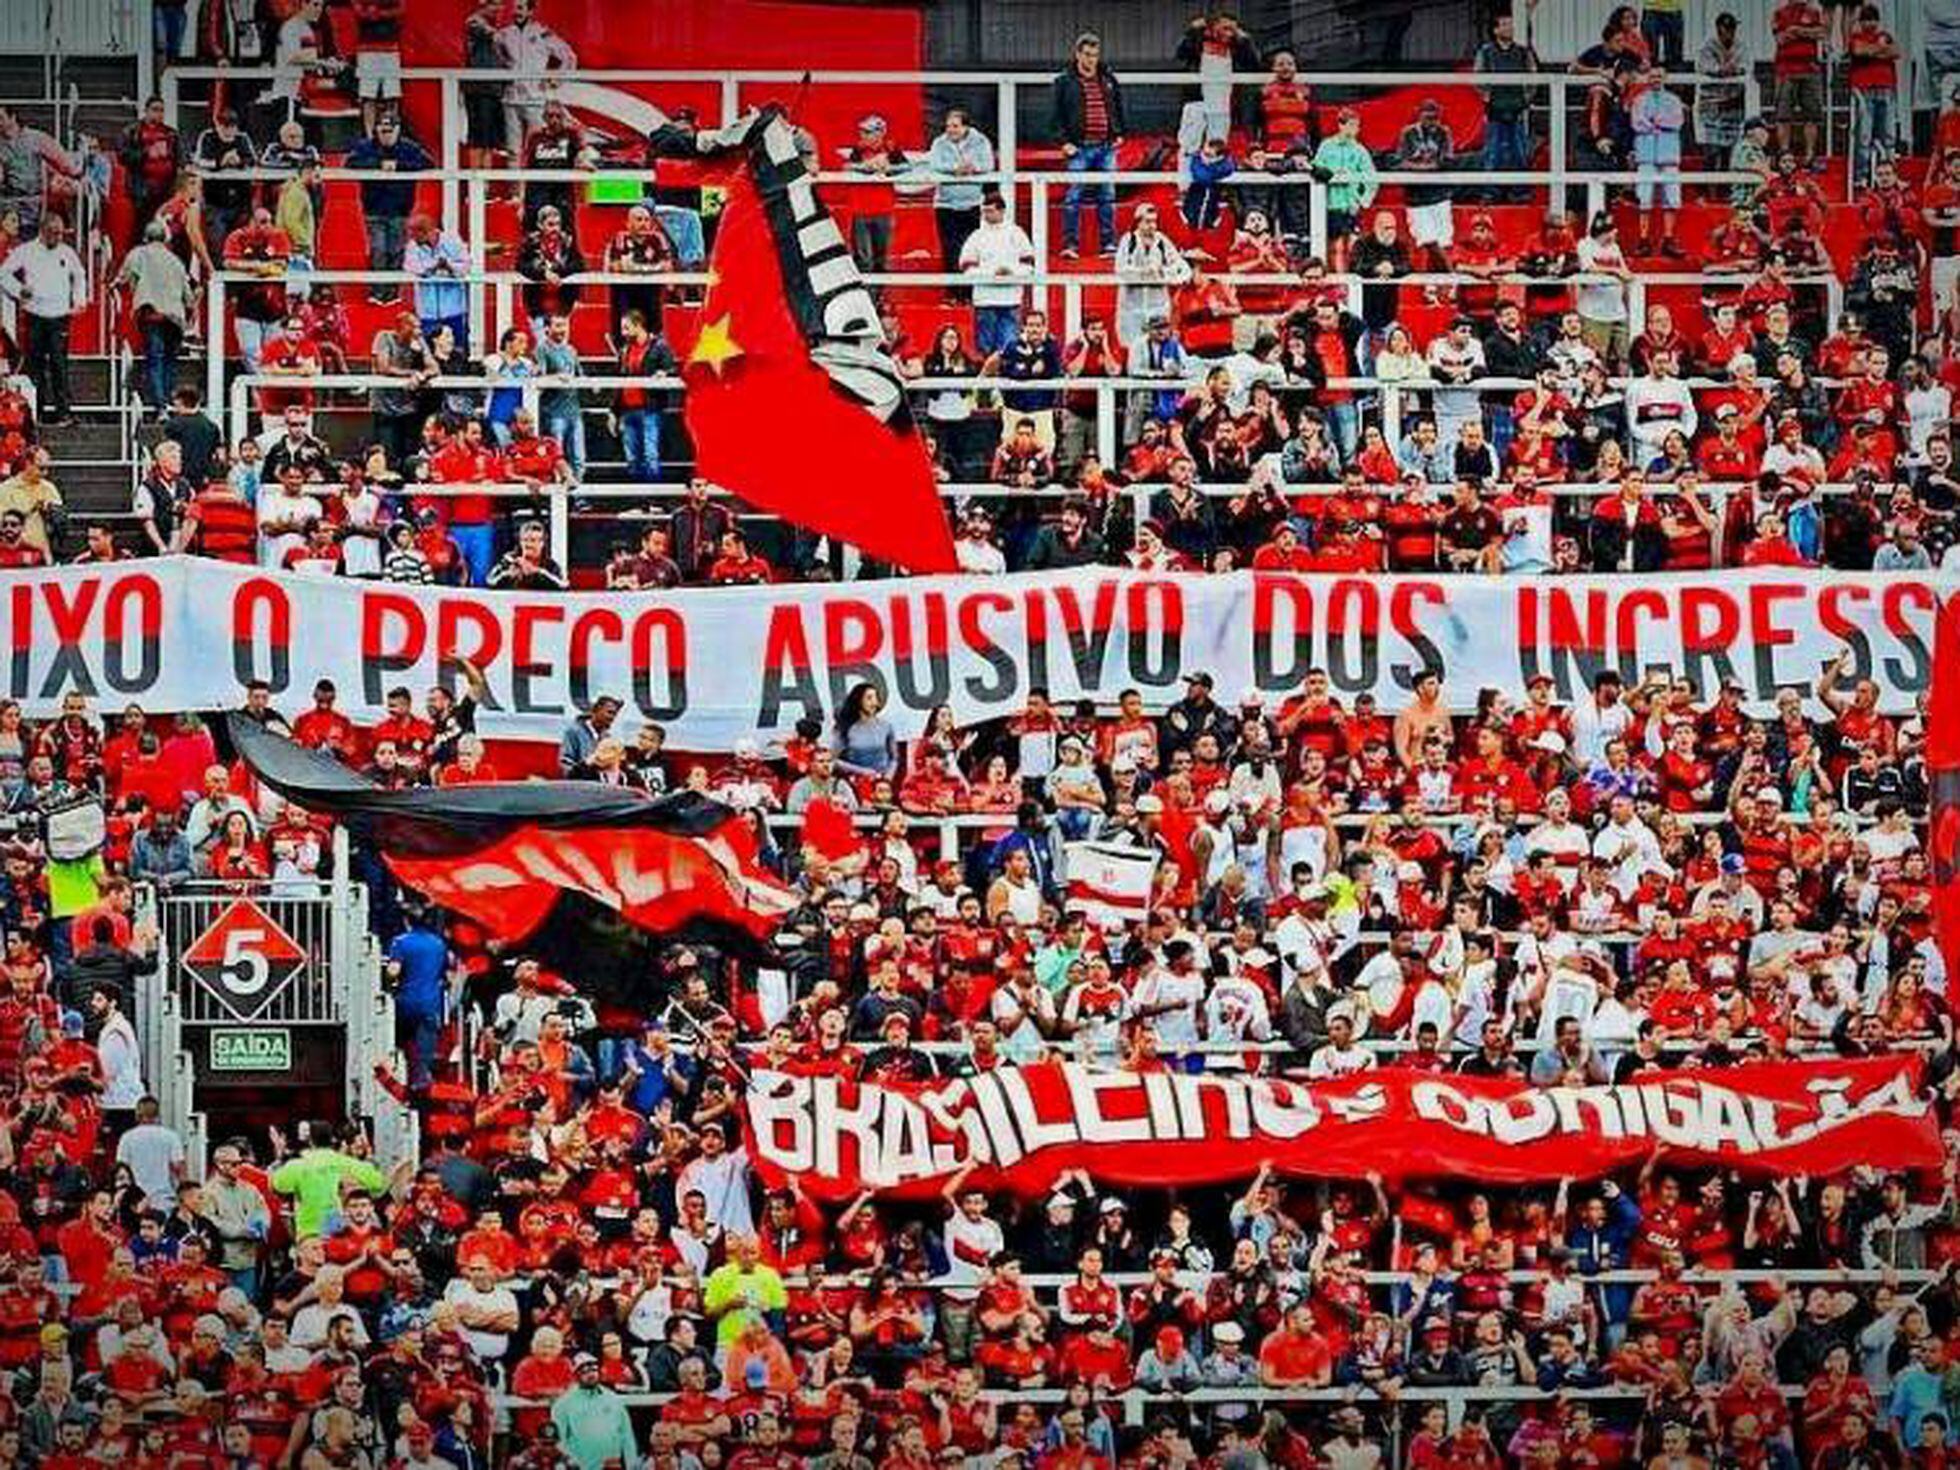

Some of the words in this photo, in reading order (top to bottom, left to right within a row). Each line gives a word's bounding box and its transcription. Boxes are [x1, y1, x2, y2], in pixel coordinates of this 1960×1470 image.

[10, 573, 162, 697] IXO
[233, 577, 289, 693] O
[757, 580, 1184, 728] ABUSIVO
[1253, 575, 1447, 692] DOS
[221, 930, 269, 994] 5
[217, 1033, 286, 1054] SAÍDA
